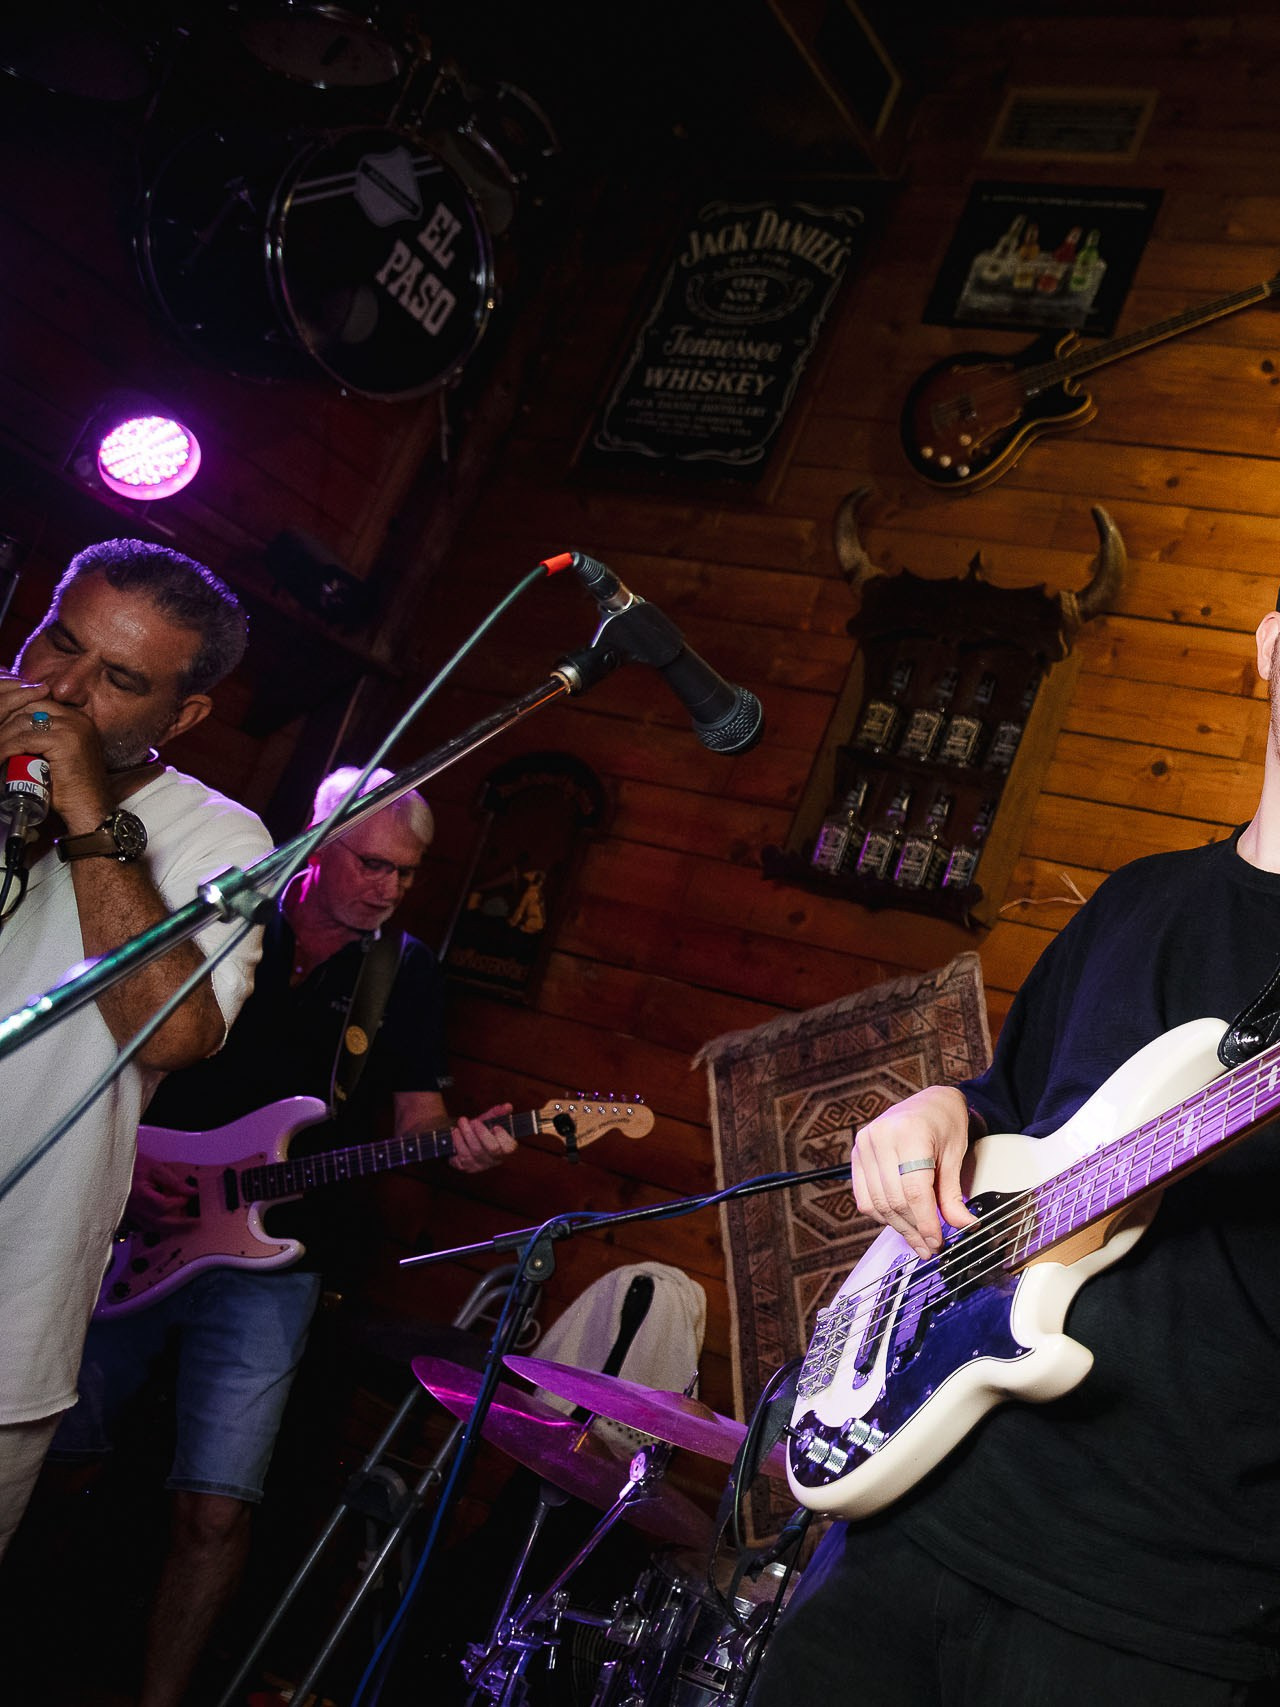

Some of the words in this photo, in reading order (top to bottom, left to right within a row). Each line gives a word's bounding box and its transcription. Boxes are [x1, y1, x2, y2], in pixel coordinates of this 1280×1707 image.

[416, 201, 463, 270] EL
[681, 221, 751, 268] JACK
[373, 239, 457, 336] PASO
[664, 325, 783, 362] Tennessee
[643, 366, 776, 397] WHISKEY
